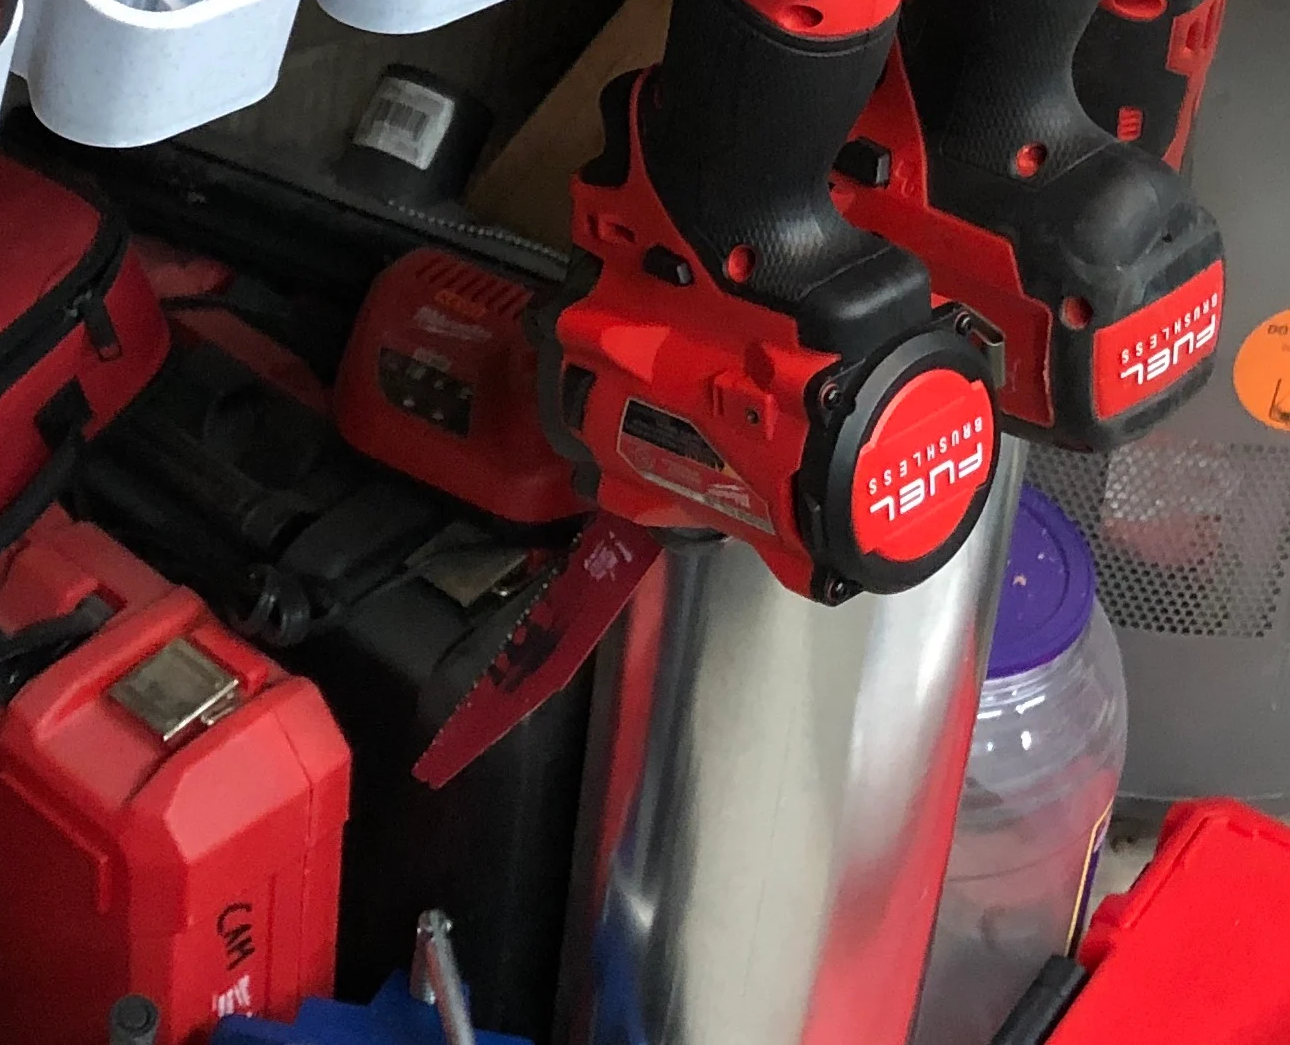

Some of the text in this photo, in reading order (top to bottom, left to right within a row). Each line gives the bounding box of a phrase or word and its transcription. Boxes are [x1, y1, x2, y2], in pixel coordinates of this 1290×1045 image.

[1120, 293, 1219, 365] BRUSHLESS
[1121, 314, 1217, 385] FUEL
[1266, 323, 1289, 337] DO
[868, 416, 984, 496] BRUSHLESS
[869, 442, 983, 522] FUEL
